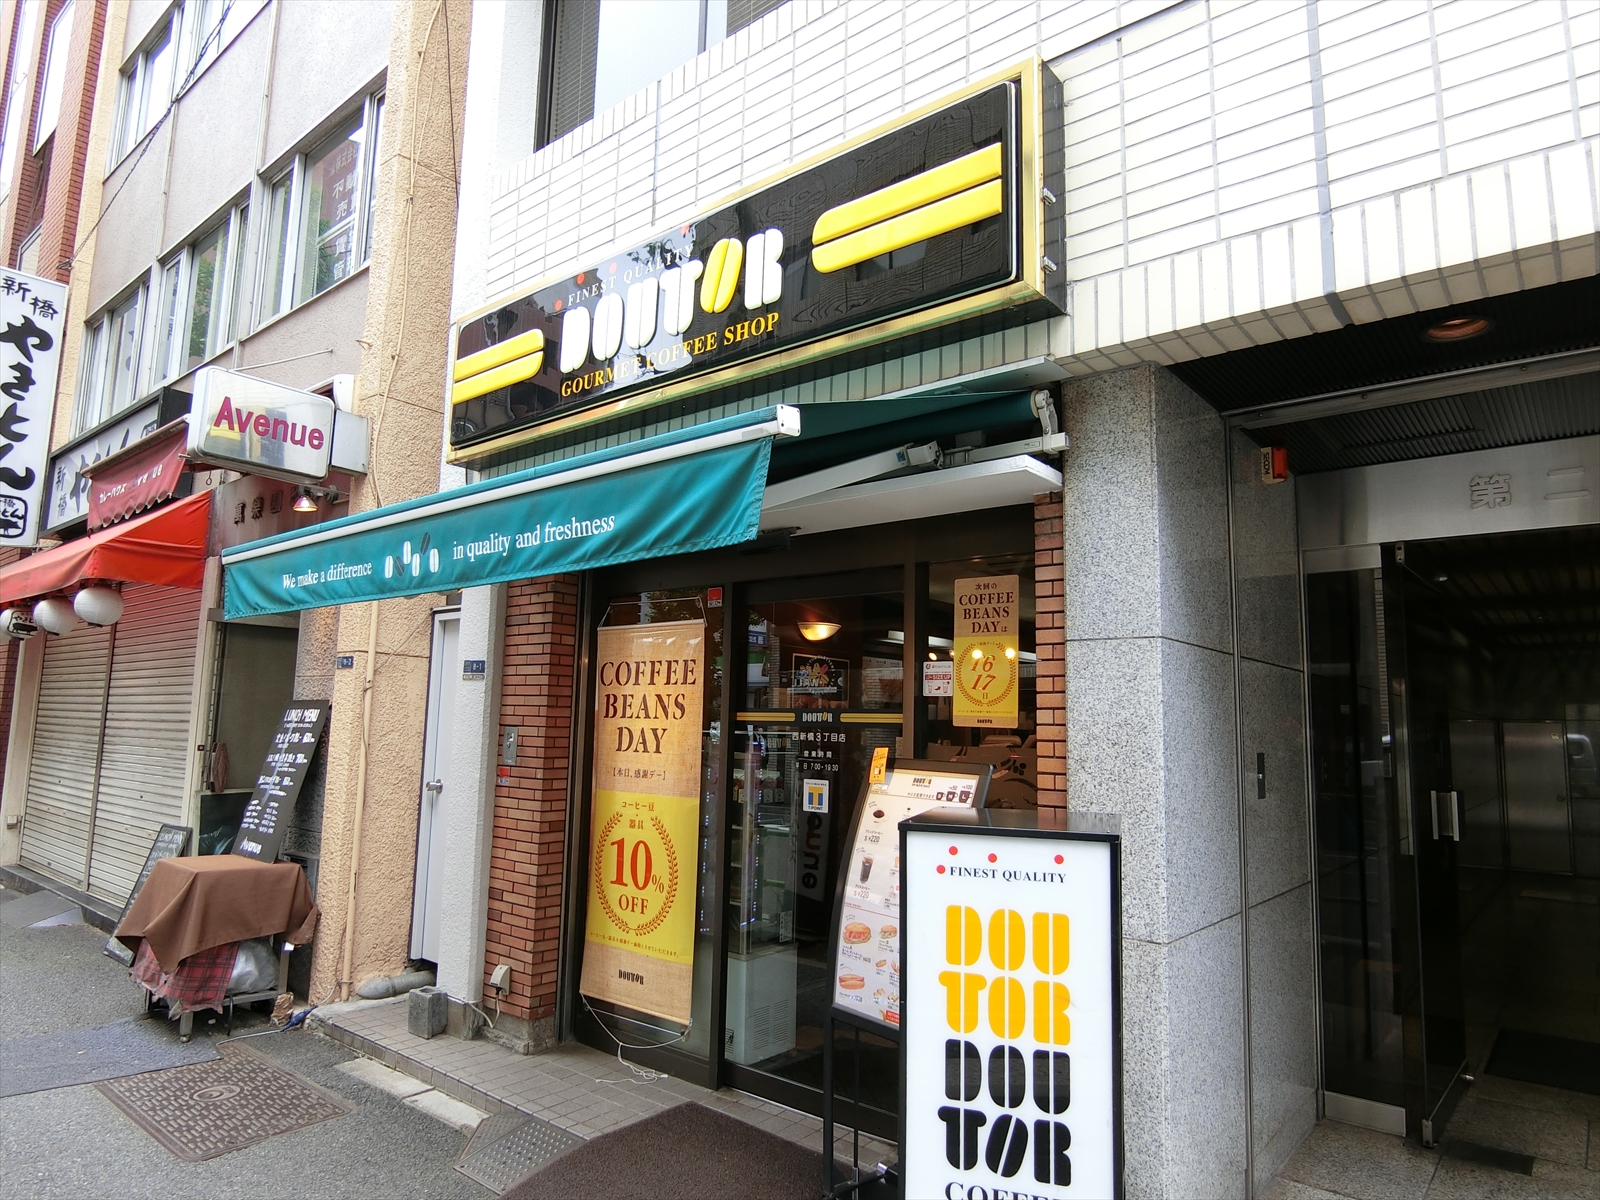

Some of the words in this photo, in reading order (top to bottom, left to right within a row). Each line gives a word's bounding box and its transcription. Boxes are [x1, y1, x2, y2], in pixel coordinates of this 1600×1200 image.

[567, 275, 617, 307] FINEST
[622, 243, 694, 284] QUALITY
[559, 228, 784, 374] DOUTOR
[560, 356, 643, 398] GOURMET
[645, 331, 718, 371] COFFEE
[723, 312, 780, 347] SHOP
[213, 396, 325, 450] Avenue
[1263, 452, 1271, 475] SECOM
[453, 541, 464, 560] in
[466, 532, 511, 562] quality
[515, 524, 540, 549] and
[544, 515, 615, 544] freshness
[283, 573, 296, 589] We
[297, 569, 319, 587] make
[320, 571, 326, 583] a
[327, 562, 373, 581] difference
[959, 591, 1014, 606] COFFEE
[963, 606, 1010, 620] BEANS
[971, 621, 1001, 634] DAY
[600, 659, 697, 687] COFFEE
[971, 673, 997, 691] 17
[603, 693, 686, 720] BEANS
[982, 692, 989, 700] 日
[302, 708, 320, 722] MENU
[802, 712, 833, 723] DOUTOR
[615, 726, 668, 754] DAY
[621, 801, 655, 812] コーヒー豆
[628, 818, 644, 831] 器具
[950, 866, 998, 880] FINEST
[1002, 869, 1067, 884] QUALITY
[618, 893, 649, 916] OFF
[945, 904, 1070, 976] DOU
[618, 968, 645, 985] DOUTOR
[938, 970, 1071, 1046] TOR
[944, 1038, 1071, 1115] DOU
[937, 1105, 1072, 1187] TOR
